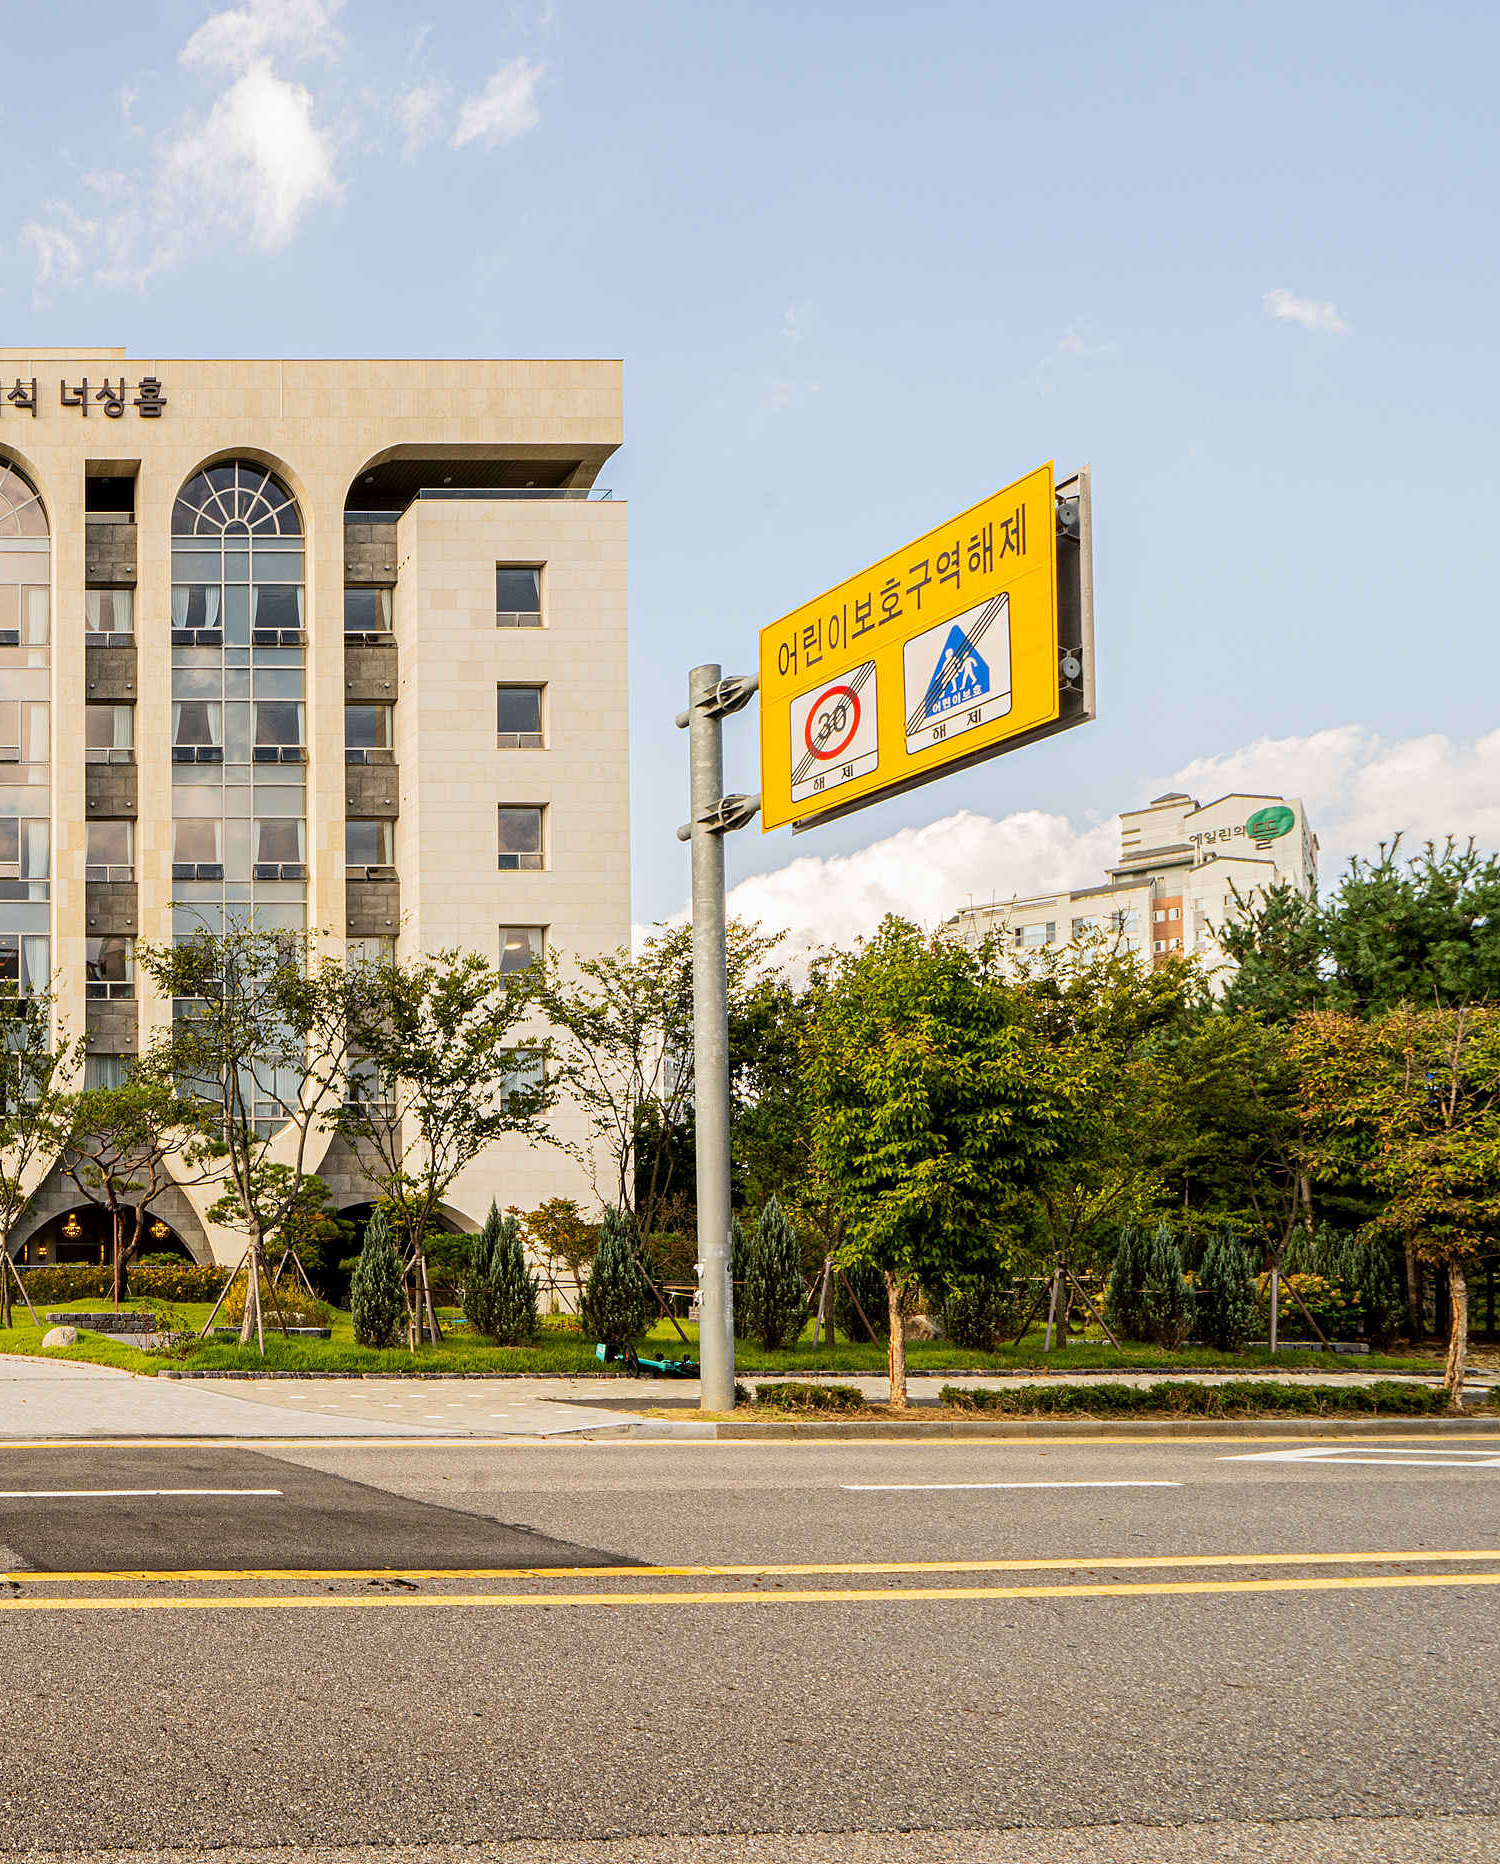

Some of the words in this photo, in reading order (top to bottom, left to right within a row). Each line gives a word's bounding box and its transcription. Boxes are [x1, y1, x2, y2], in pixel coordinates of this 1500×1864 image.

[60, 376, 168, 418] 너싱홈
[778, 503, 1027, 677] 어린이보호구역해제
[932, 684, 983, 713] 어린이보호
[818, 705, 847, 740] 30
